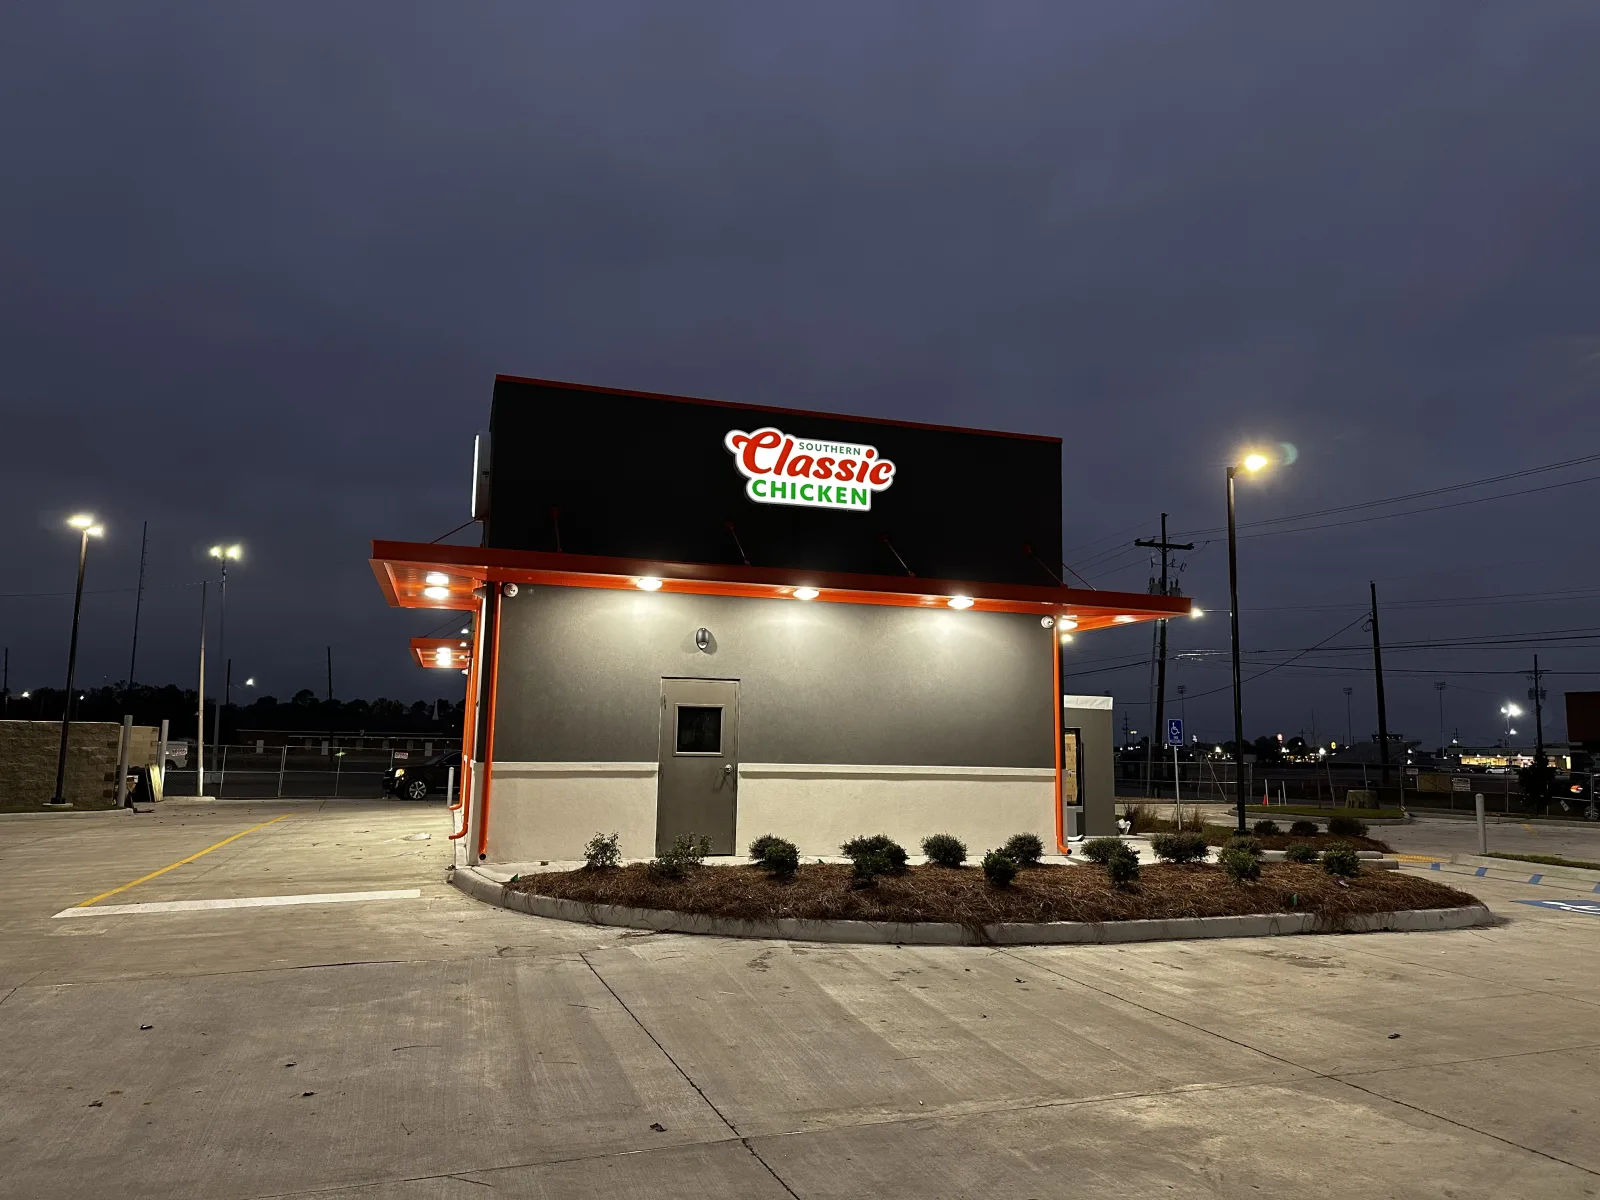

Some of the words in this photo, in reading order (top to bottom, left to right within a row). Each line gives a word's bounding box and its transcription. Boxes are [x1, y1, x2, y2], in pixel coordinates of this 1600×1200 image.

[732, 432, 892, 484] Classic
[798, 441, 861, 456] SOUTHERN
[752, 479, 867, 505] CHICKEN
